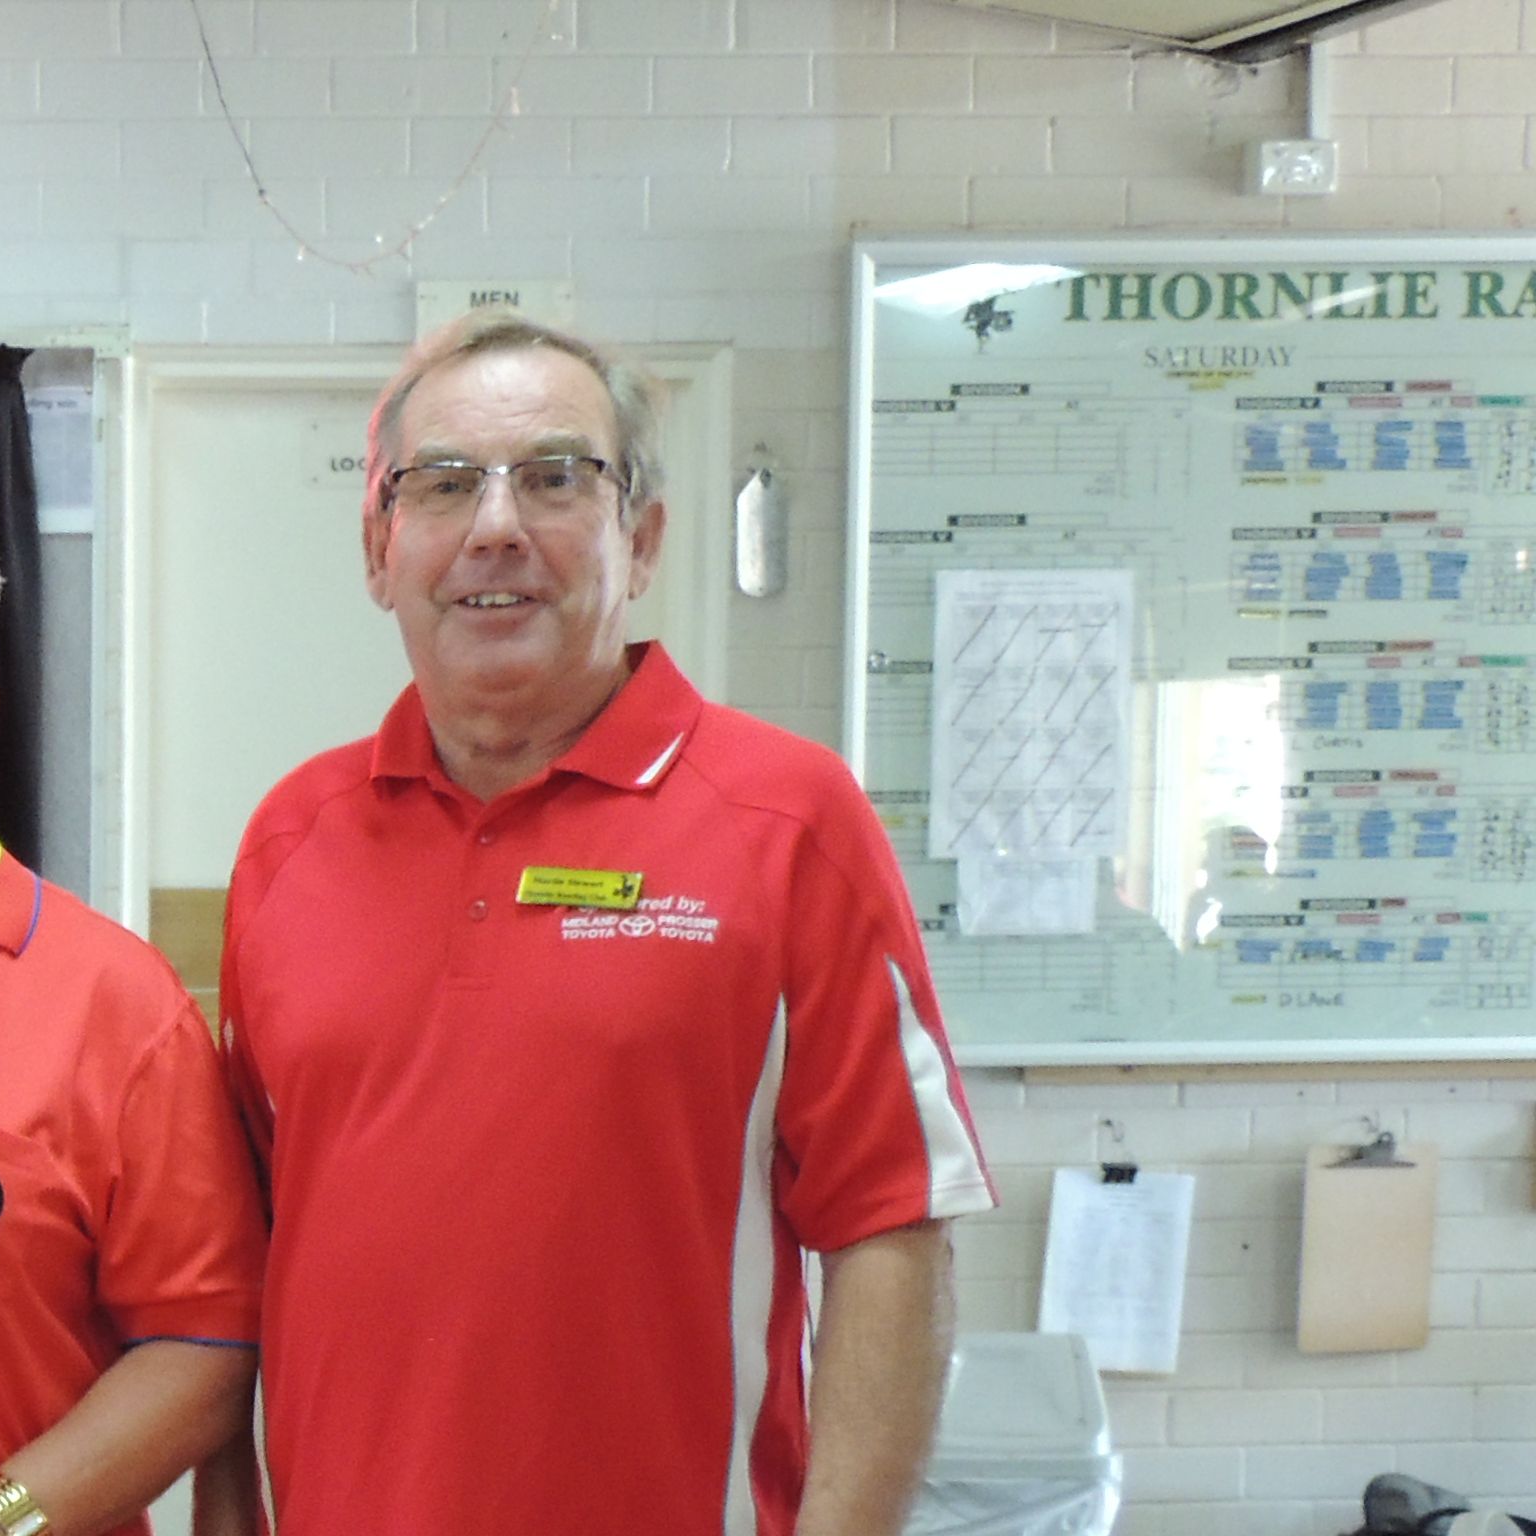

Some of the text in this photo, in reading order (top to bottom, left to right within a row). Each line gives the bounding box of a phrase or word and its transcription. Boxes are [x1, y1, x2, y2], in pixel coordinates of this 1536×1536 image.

[1058, 270, 1439, 322] THORNLIE
[1144, 345, 1296, 368] SATURDAY
[330, 457, 368, 473] LOC
[562, 928, 616, 940] TOYOTA
[660, 927, 715, 943] TOYOTA
